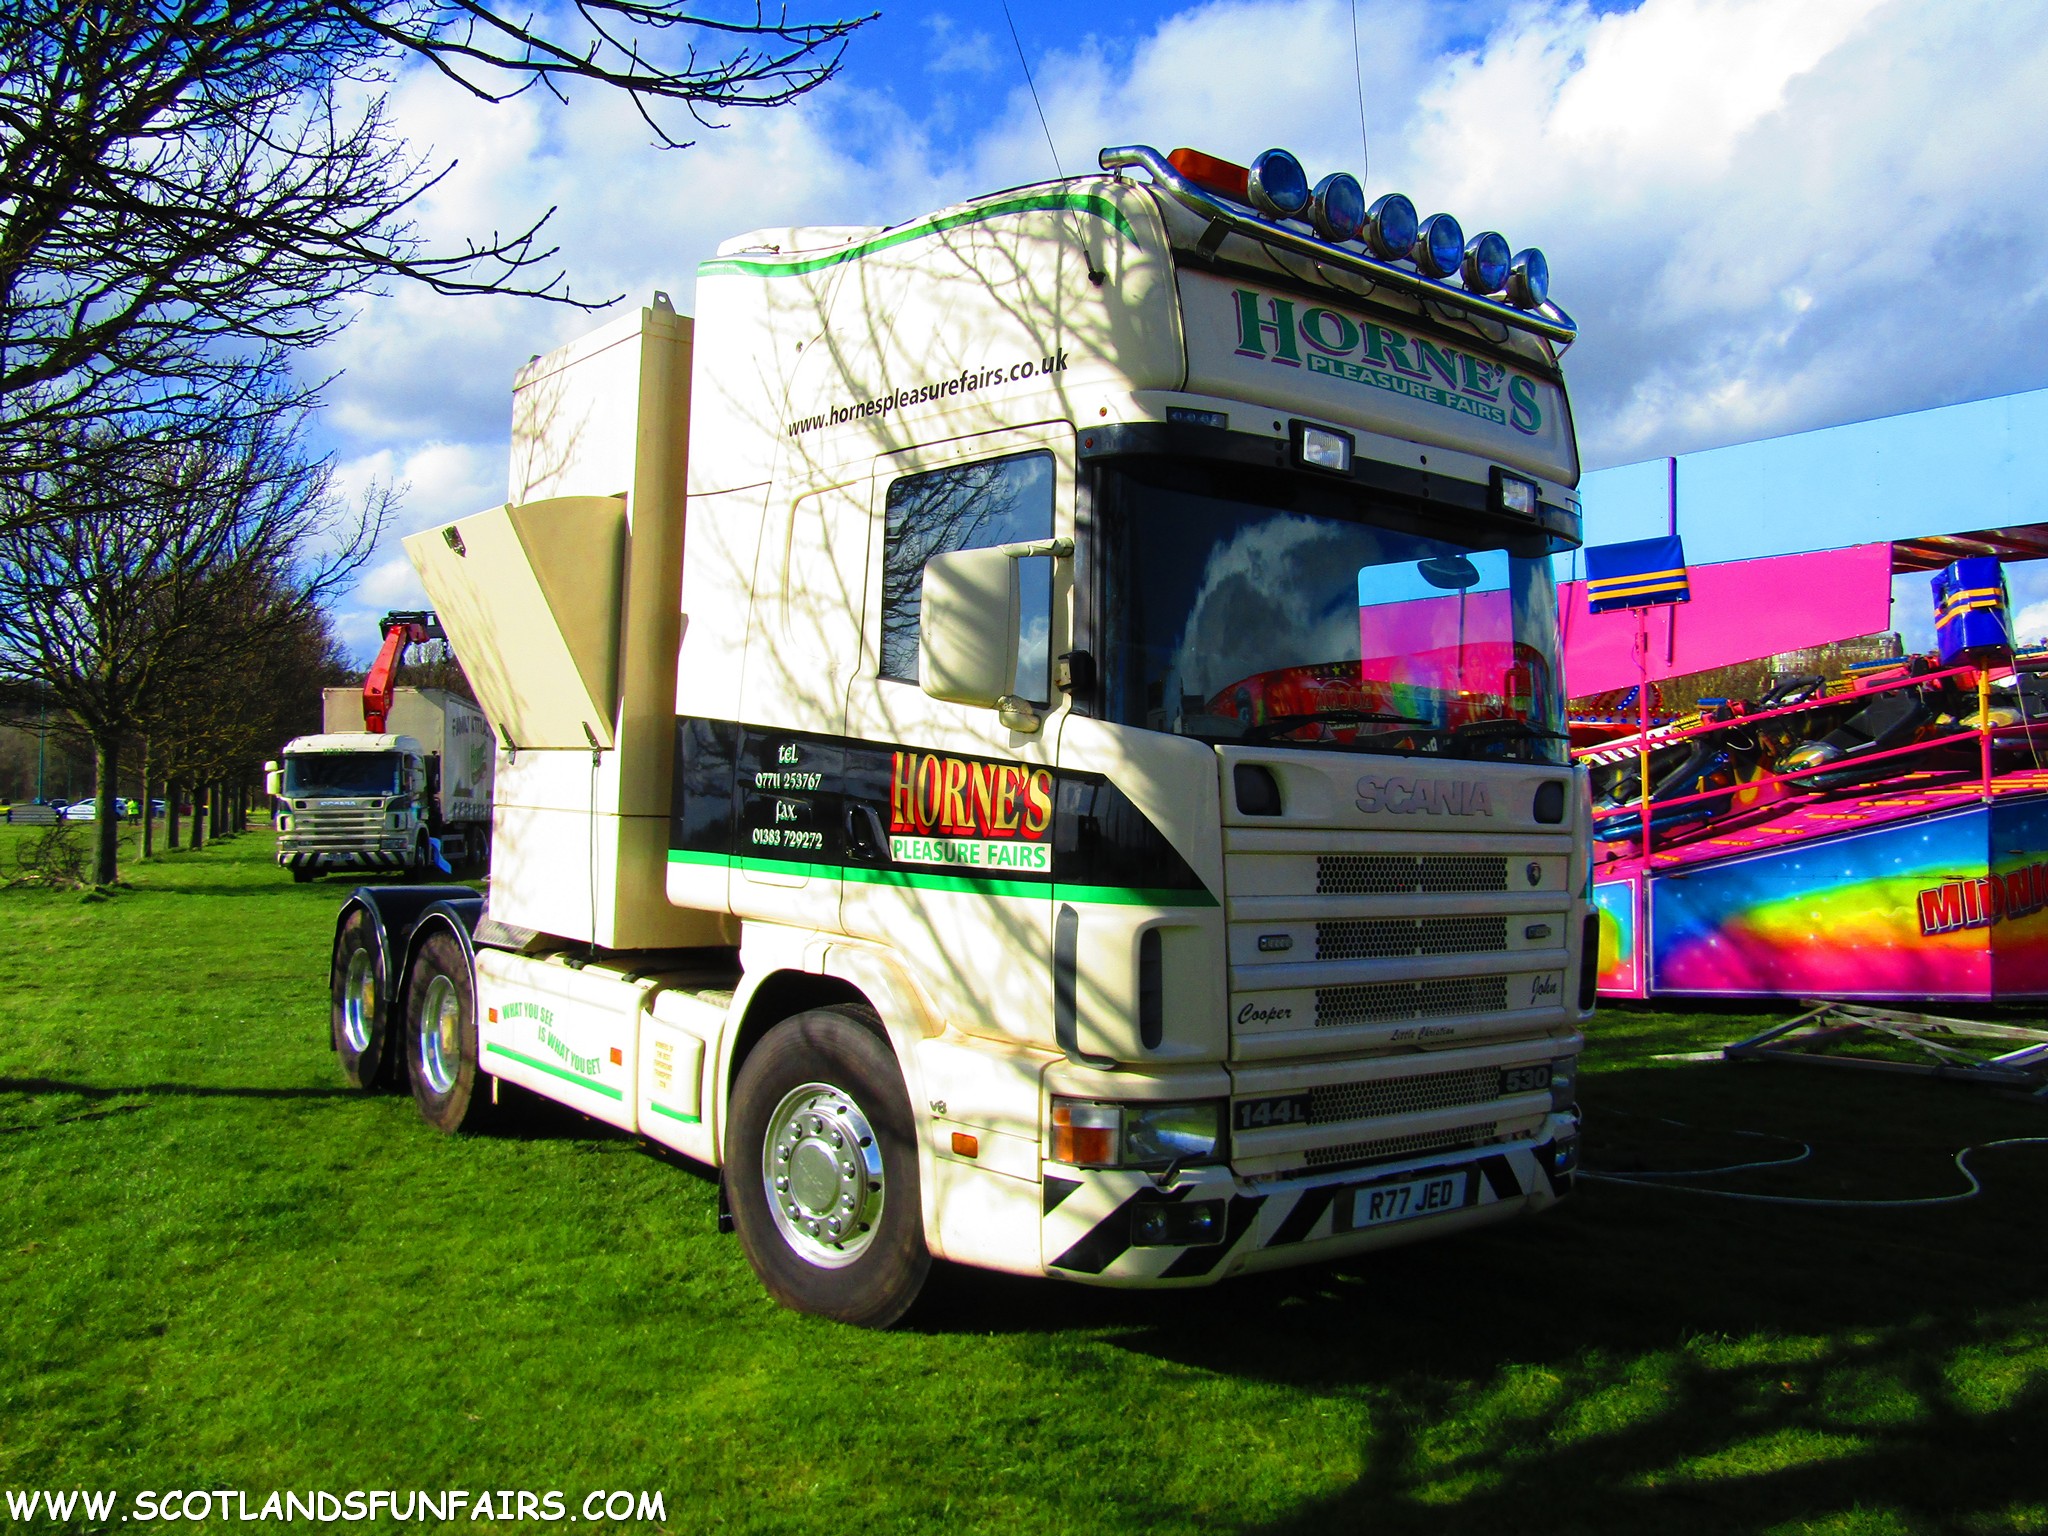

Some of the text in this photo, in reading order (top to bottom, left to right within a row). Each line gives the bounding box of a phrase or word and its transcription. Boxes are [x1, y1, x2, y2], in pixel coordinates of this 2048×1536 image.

[1231, 288, 1543, 436] HORNE'S
[788, 347, 1069, 437] www.hornespleasurefairs.co.uk
[1310, 355, 1504, 425] PLEASURE FAIRS
[755, 772, 822, 791] 07711 253767
[890, 751, 1054, 840] HORNE'S
[1355, 774, 1493, 817] SCANIA
[752, 828, 823, 850] 01383 729272
[893, 839, 1046, 868] PLEASURE FAIRS
[1917, 861, 2048, 935] MIDNI
[1530, 975, 1557, 1005] John
[502, 1002, 553, 1028] WHAT YOU SEE
[1237, 1003, 1293, 1024] Cooper
[538, 1025, 601, 1075] IS WHAT YOU GET
[1506, 1067, 1549, 1091] 530
[930, 1100, 947, 1115] V8
[1369, 1179, 1453, 1220] R77 JED
